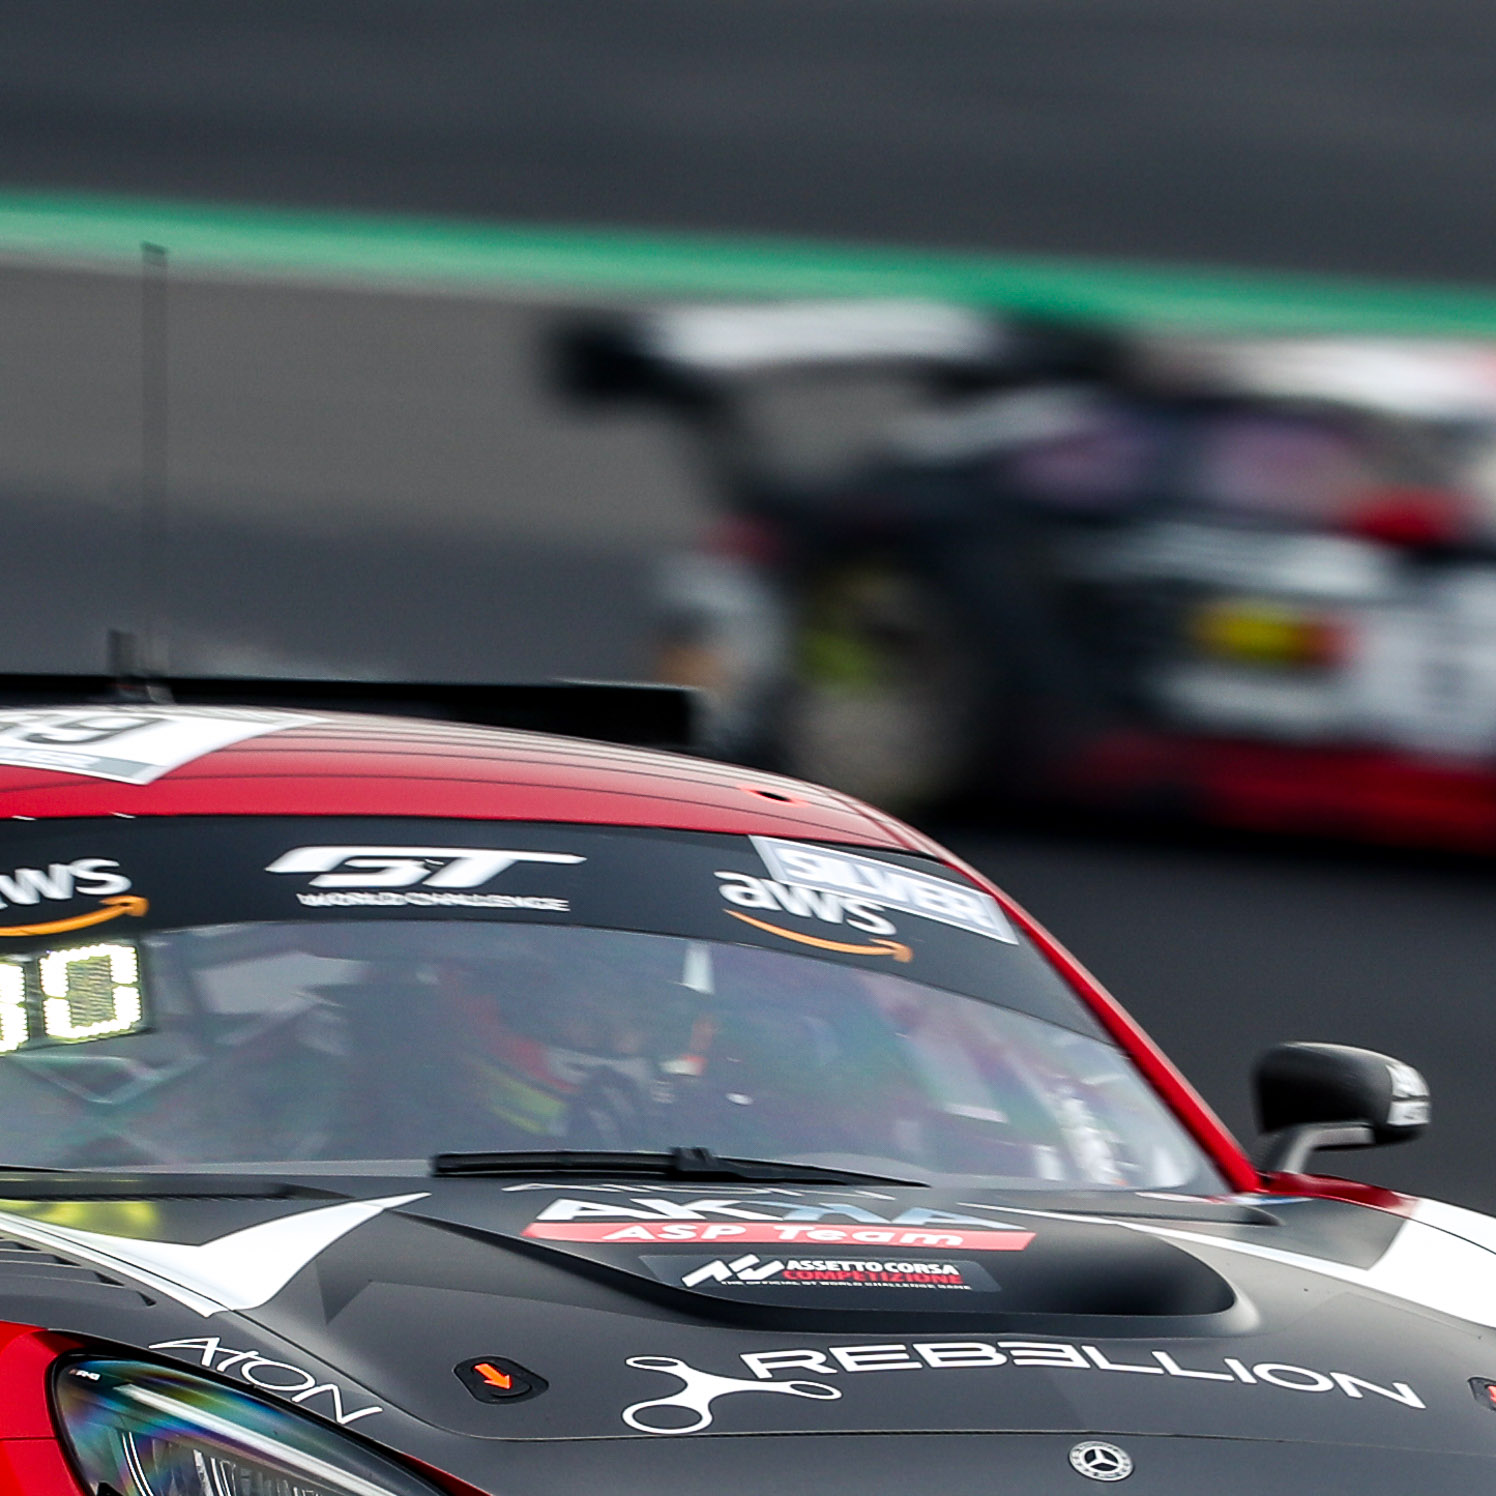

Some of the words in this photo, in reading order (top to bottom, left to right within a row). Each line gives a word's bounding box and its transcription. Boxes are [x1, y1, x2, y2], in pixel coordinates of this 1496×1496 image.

[265, 846, 587, 888] GT
[713, 871, 896, 935] aws
[603, 1225, 748, 1242] ASP
[773, 1225, 963, 1247] Team
[782, 1270, 963, 1285] COMPETIZIONE
[787, 1260, 883, 1273] ASSETTO
[884, 1262, 961, 1275] CORSA
